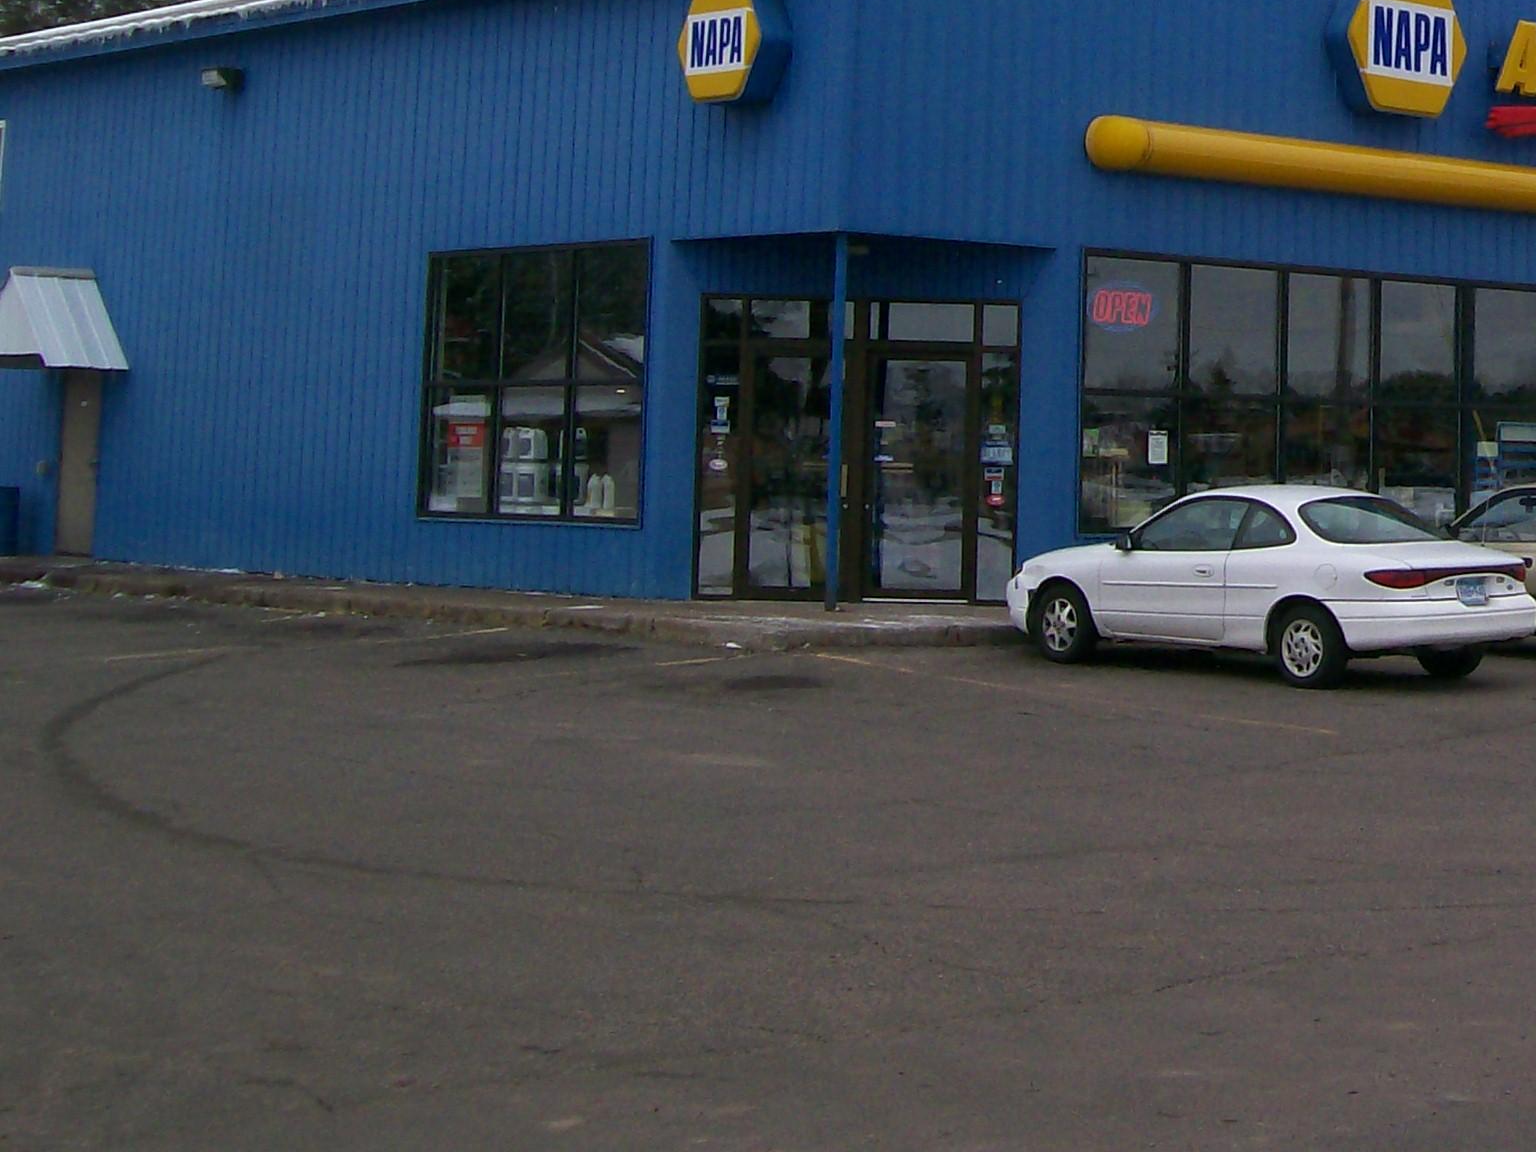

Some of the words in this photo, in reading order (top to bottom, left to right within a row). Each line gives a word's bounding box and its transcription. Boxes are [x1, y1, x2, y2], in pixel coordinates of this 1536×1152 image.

[690, 16, 742, 68] NAPA
[1373, 5, 1448, 78] NAPA
[1093, 289, 1152, 326] OPEN
